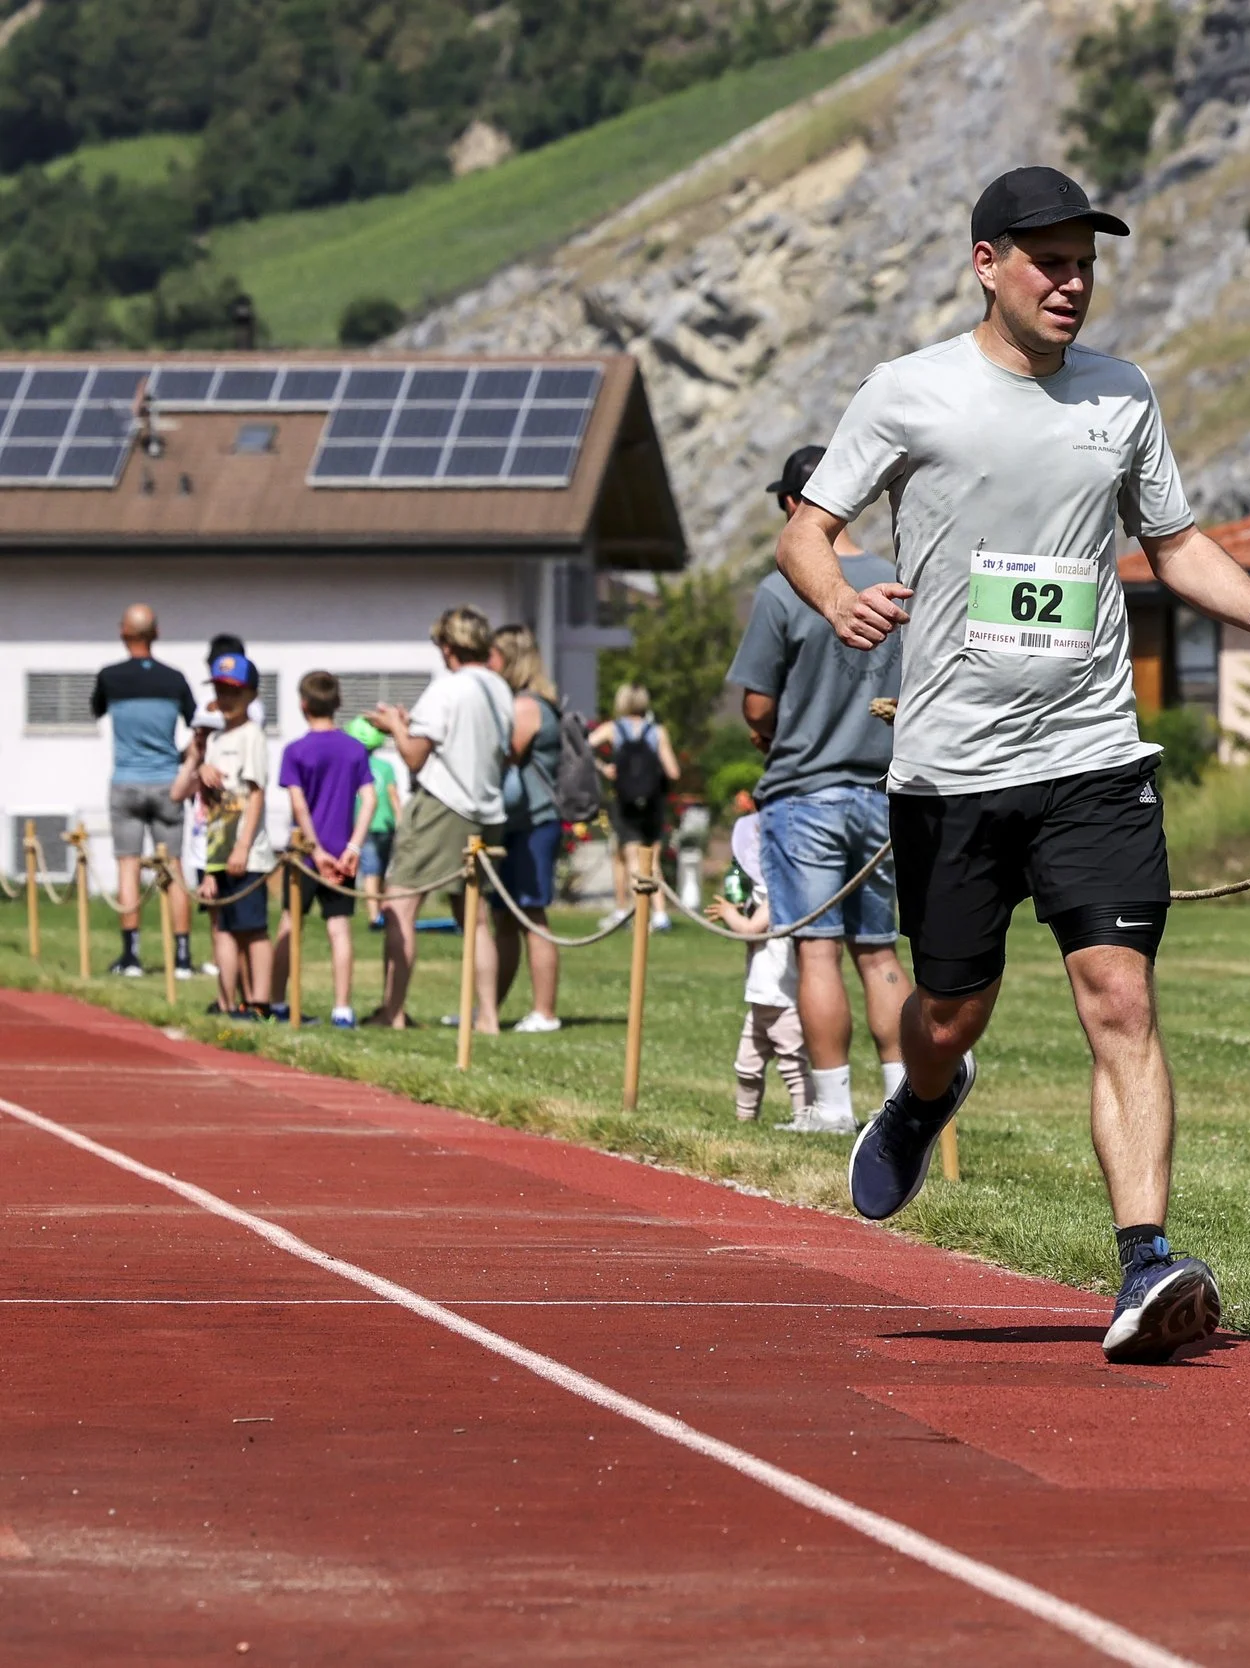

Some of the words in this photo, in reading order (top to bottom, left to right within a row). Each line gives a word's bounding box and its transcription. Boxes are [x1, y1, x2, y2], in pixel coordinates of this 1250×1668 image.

[982, 559, 996, 569] stv
[1006, 562, 1036, 573] gampel
[1054, 561, 1092, 576] lonzalauf
[1011, 582, 1063, 623] 62
[969, 630, 1016, 644] RAIFFEISEN
[1053, 638, 1091, 650] RAIFFEISEN
